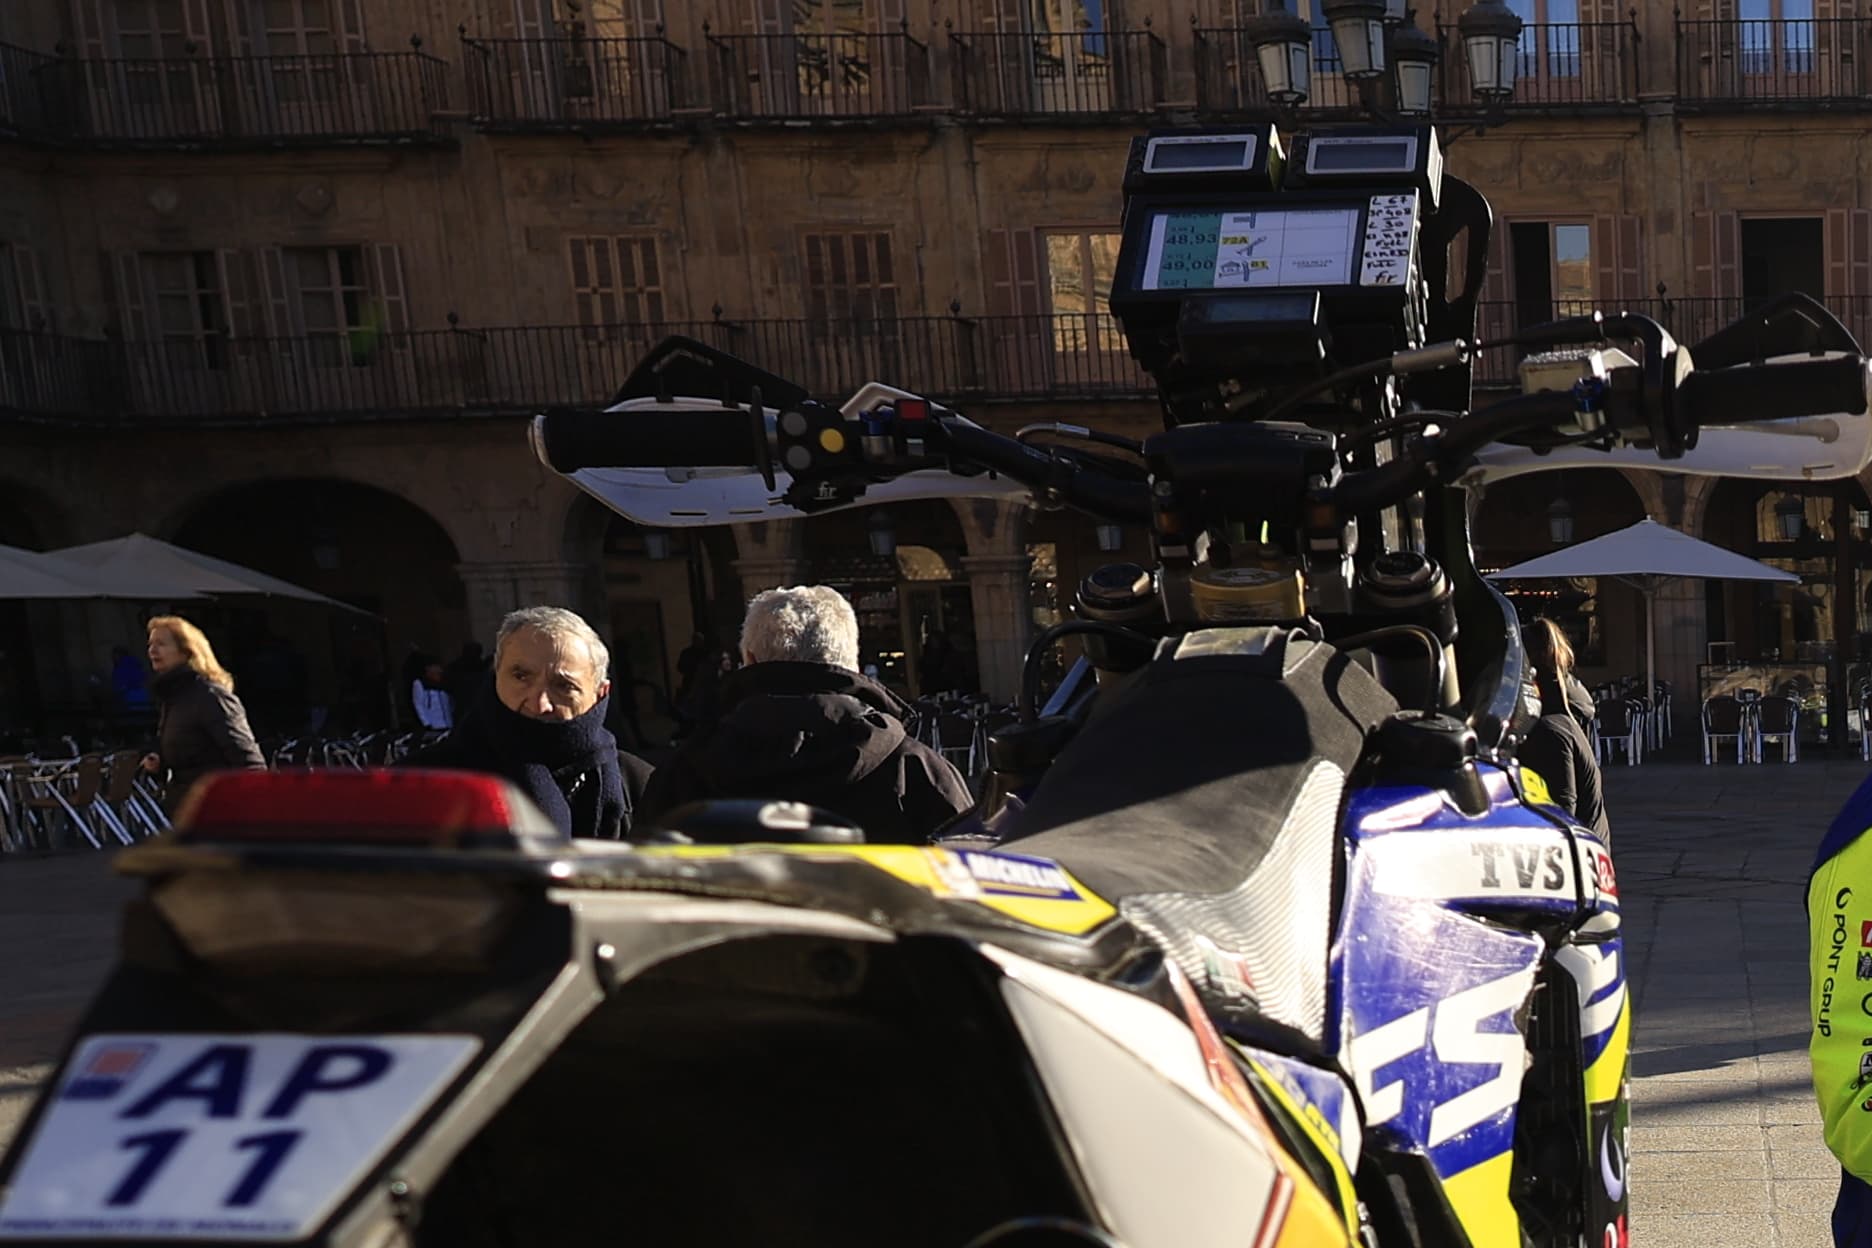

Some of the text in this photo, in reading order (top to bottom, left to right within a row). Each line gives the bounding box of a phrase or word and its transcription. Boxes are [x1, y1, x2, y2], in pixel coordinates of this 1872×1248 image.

[1471, 841, 1565, 891] TVS
[1816, 913, 1847, 1038] PONT GRUP
[117, 1042, 398, 1121] AP
[104, 1128, 308, 1208] 11
